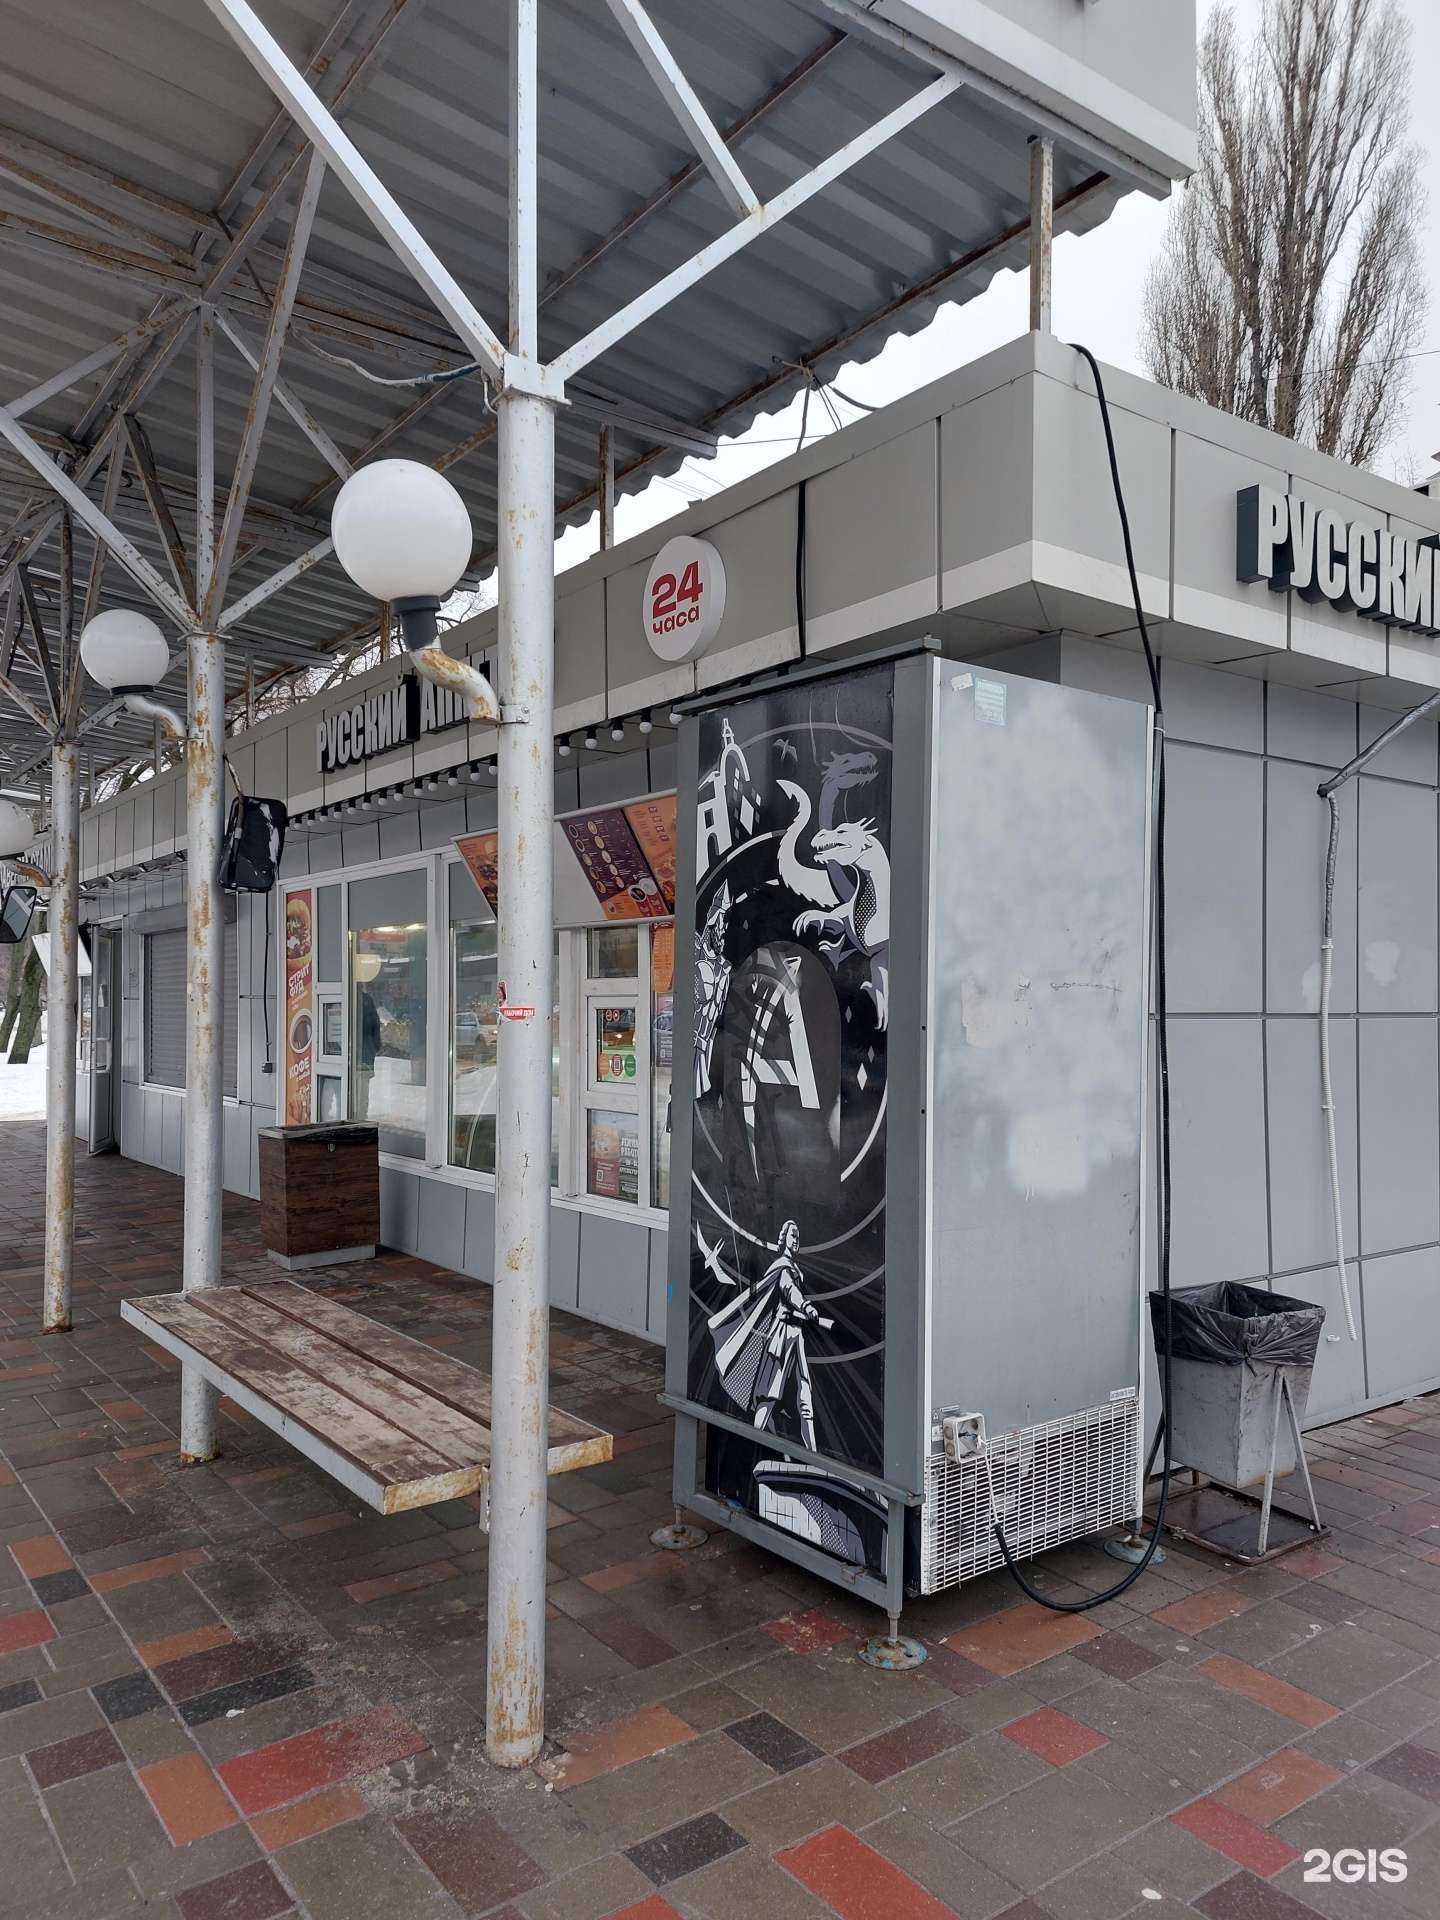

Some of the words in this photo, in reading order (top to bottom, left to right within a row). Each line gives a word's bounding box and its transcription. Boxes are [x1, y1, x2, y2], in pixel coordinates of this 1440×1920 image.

[1254, 484, 1440, 628] РУССКИ
[651, 560, 703, 619] 24
[652, 605, 700, 635] часа
